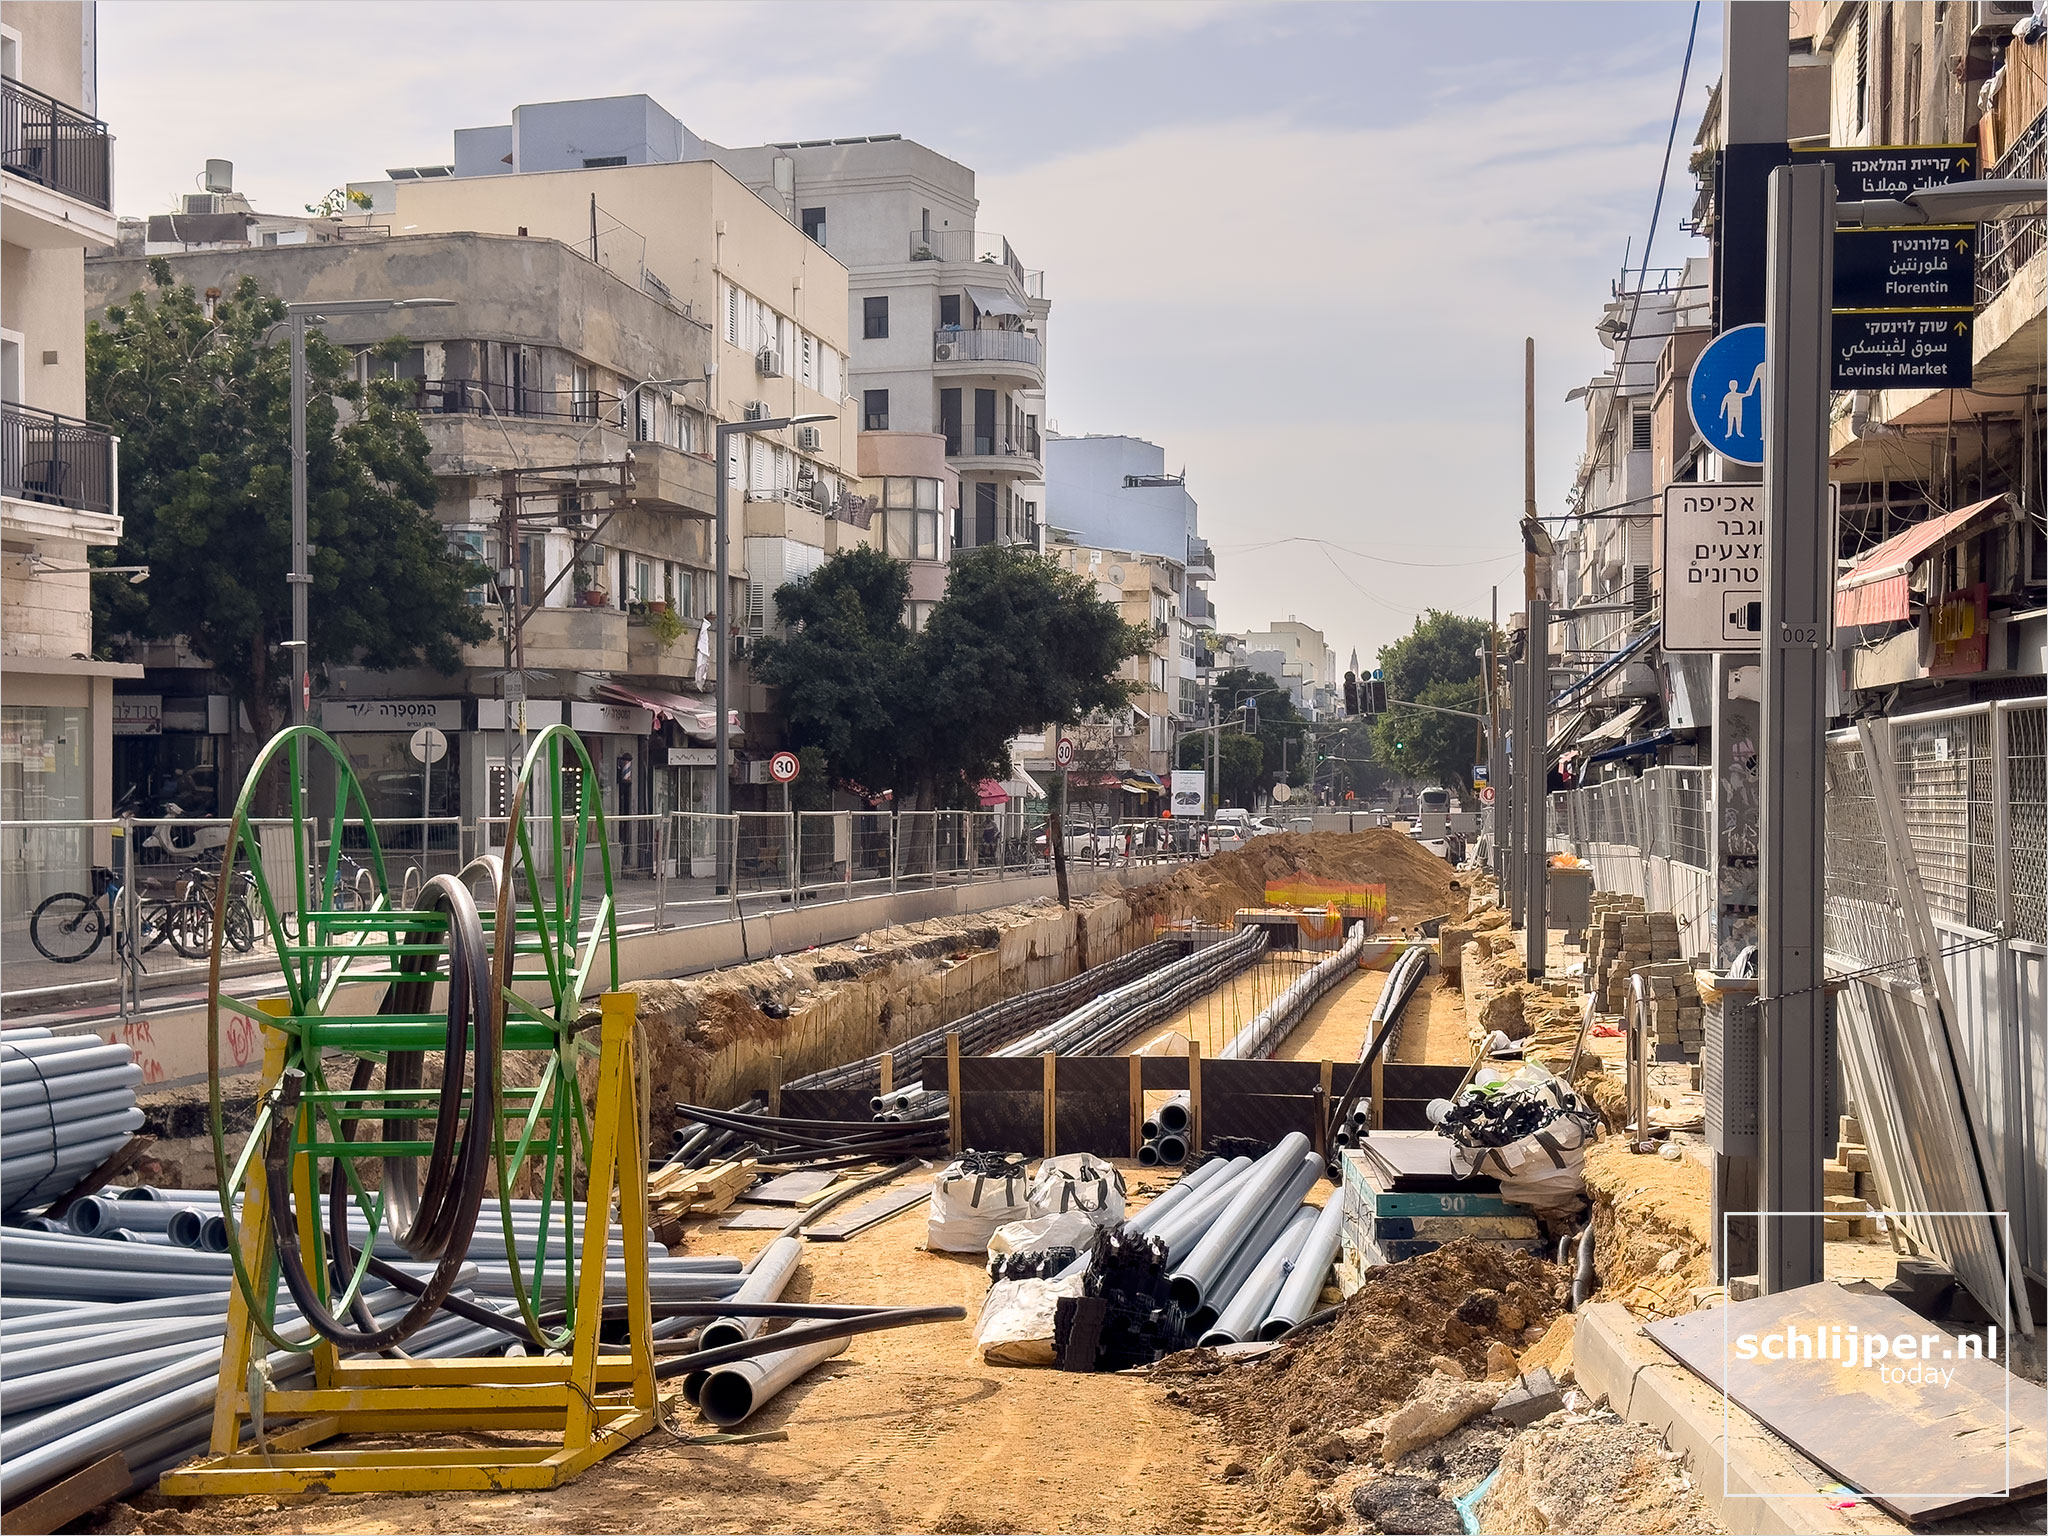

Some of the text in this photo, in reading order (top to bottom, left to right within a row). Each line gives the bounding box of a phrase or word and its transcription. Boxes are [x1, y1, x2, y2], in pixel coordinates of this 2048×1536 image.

[1851, 158, 1951, 172] קריית המלאכה
[1891, 237, 1950, 253] פלורנטין
[1889, 256, 1948, 275] فلورنتين
[1885, 281, 1949, 294] Florentin
[1865, 320, 1948, 336] שוק לוינסקי
[1911, 339, 1948, 359] سوق
[1838, 362, 1948, 376] Levinski Market
[1683, 496, 1755, 513] אכיפה
[1782, 628, 1817, 643] 002
[1058, 746, 1071, 759] 30
[775, 760, 794, 774] 30
[1440, 1196, 1465, 1212] 90
